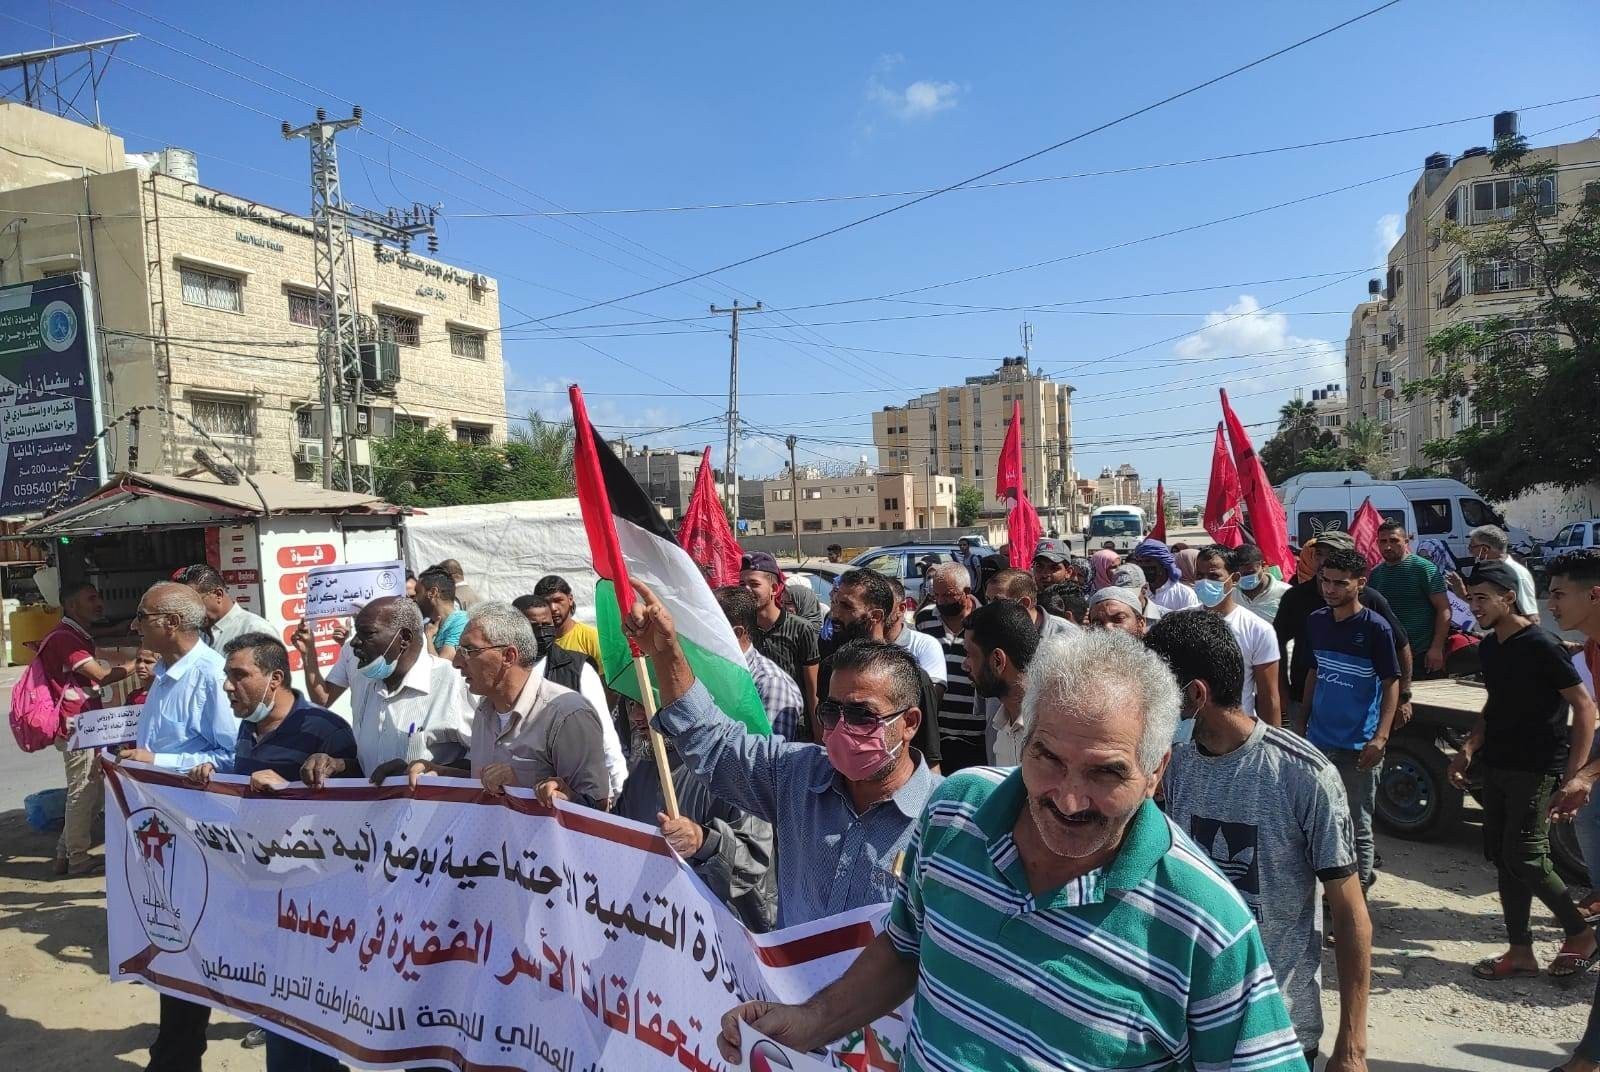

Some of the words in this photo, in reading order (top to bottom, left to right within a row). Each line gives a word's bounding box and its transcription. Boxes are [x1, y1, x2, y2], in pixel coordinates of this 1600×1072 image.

[0, 314, 14, 327] الألما
[0, 331, 26, 342] وجراح
[0, 340, 41, 355] العظ
[36, 371, 70, 397] سفيان
[4, 409, 11, 424] في
[12, 405, 46, 422] واستشاري
[32, 421, 53, 435] العظام
[54, 420, 75, 431] جراحة
[31, 464, 46, 475] 200
[325, 577, 338, 588] من
[339, 586, 363, 603] أعيش
[364, 586, 374, 600] أن
[308, 592, 338, 604] بكرامة
[247, 828, 326, 866] تضمن
[384, 832, 437, 888] بوضع
[439, 834, 578, 910] الاجتماعية
[277, 888, 356, 953] موعدها
[583, 871, 686, 952] التنمية
[359, 905, 386, 972] في
[387, 912, 492, 983] الفقيرة
[201, 956, 267, 987] فلسطين
[494, 927, 575, 997] الأسر
[270, 972, 313, 1001] لتحرير
[315, 981, 406, 1035] الديمقراطية
[581, 960, 727, 1072] ستحقاقات
[417, 1005, 485, 1042] للجبهة
[495, 1023, 574, 1072] العمالي
